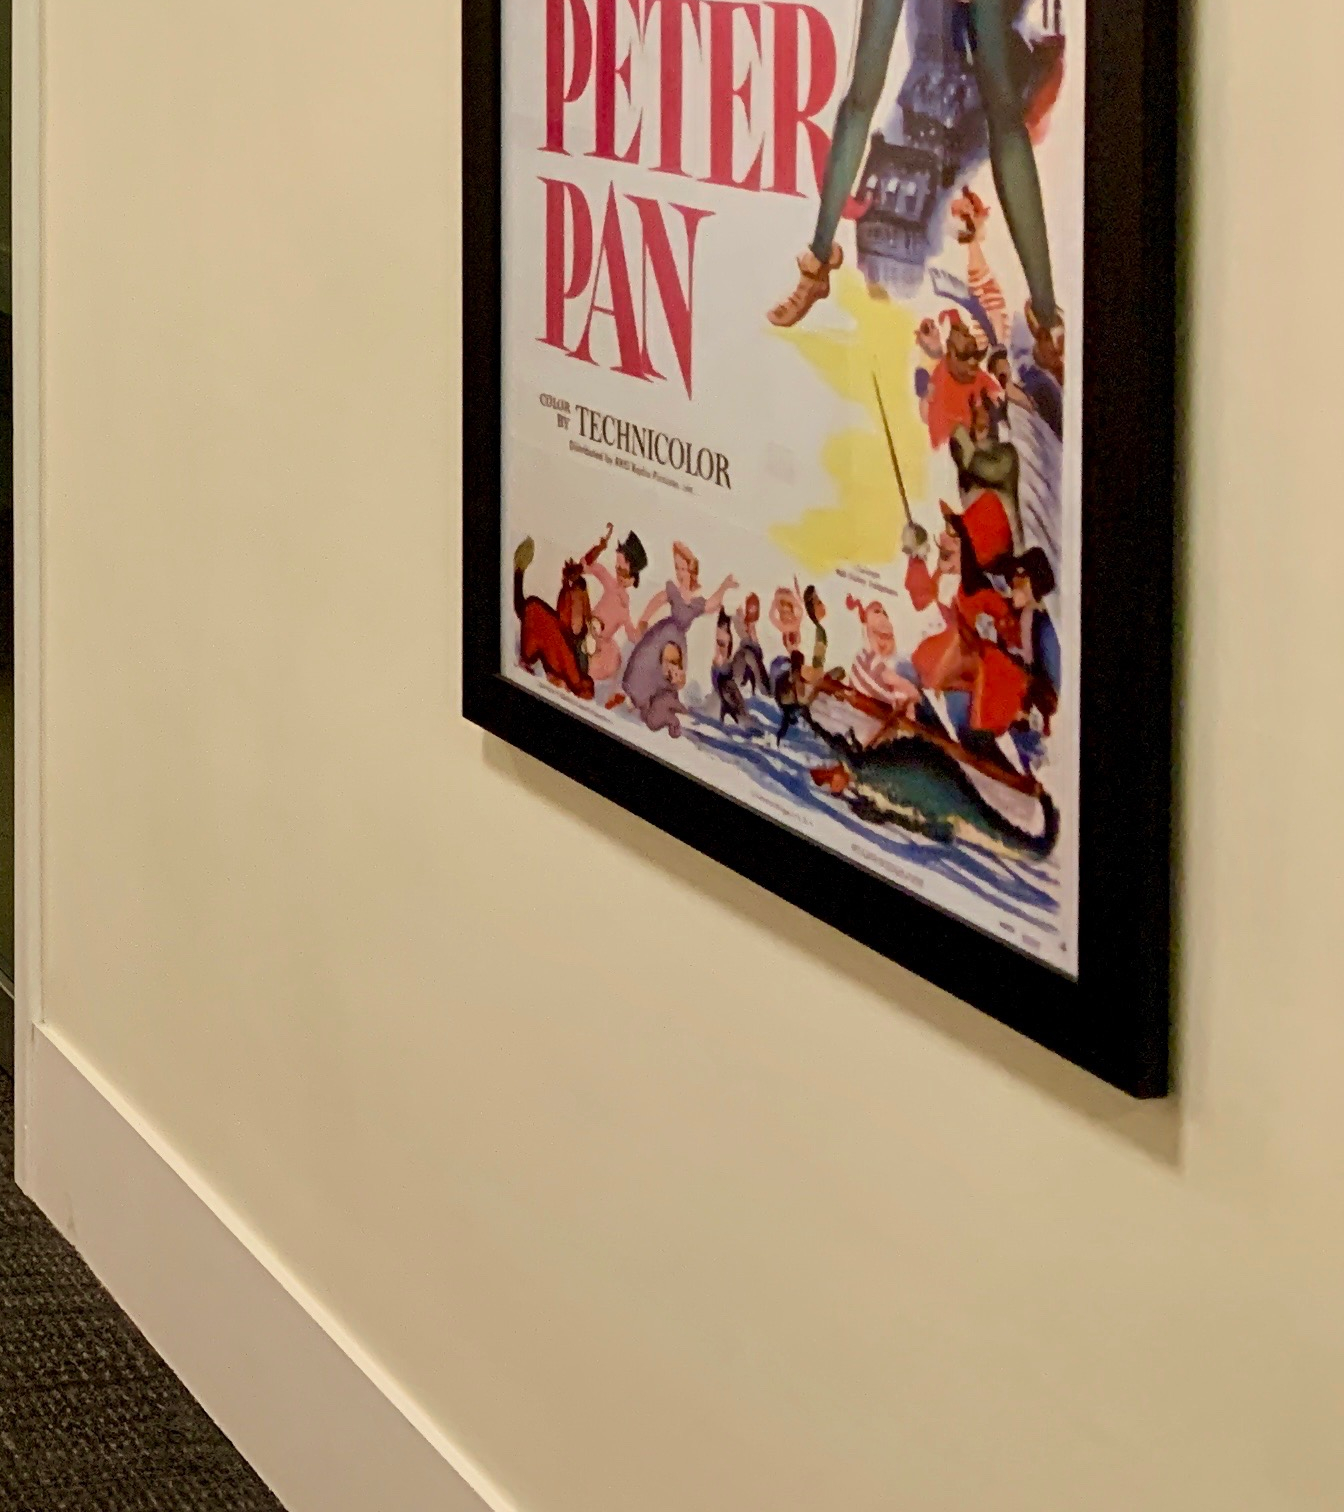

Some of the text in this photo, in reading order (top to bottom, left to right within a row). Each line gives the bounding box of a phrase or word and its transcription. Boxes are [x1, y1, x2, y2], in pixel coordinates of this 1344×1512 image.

[535, 176, 716, 401] PAN
[539, 393, 571, 413] COLOR
[575, 404, 732, 489] TECHNICOLOR
[557, 413, 571, 431] BY
